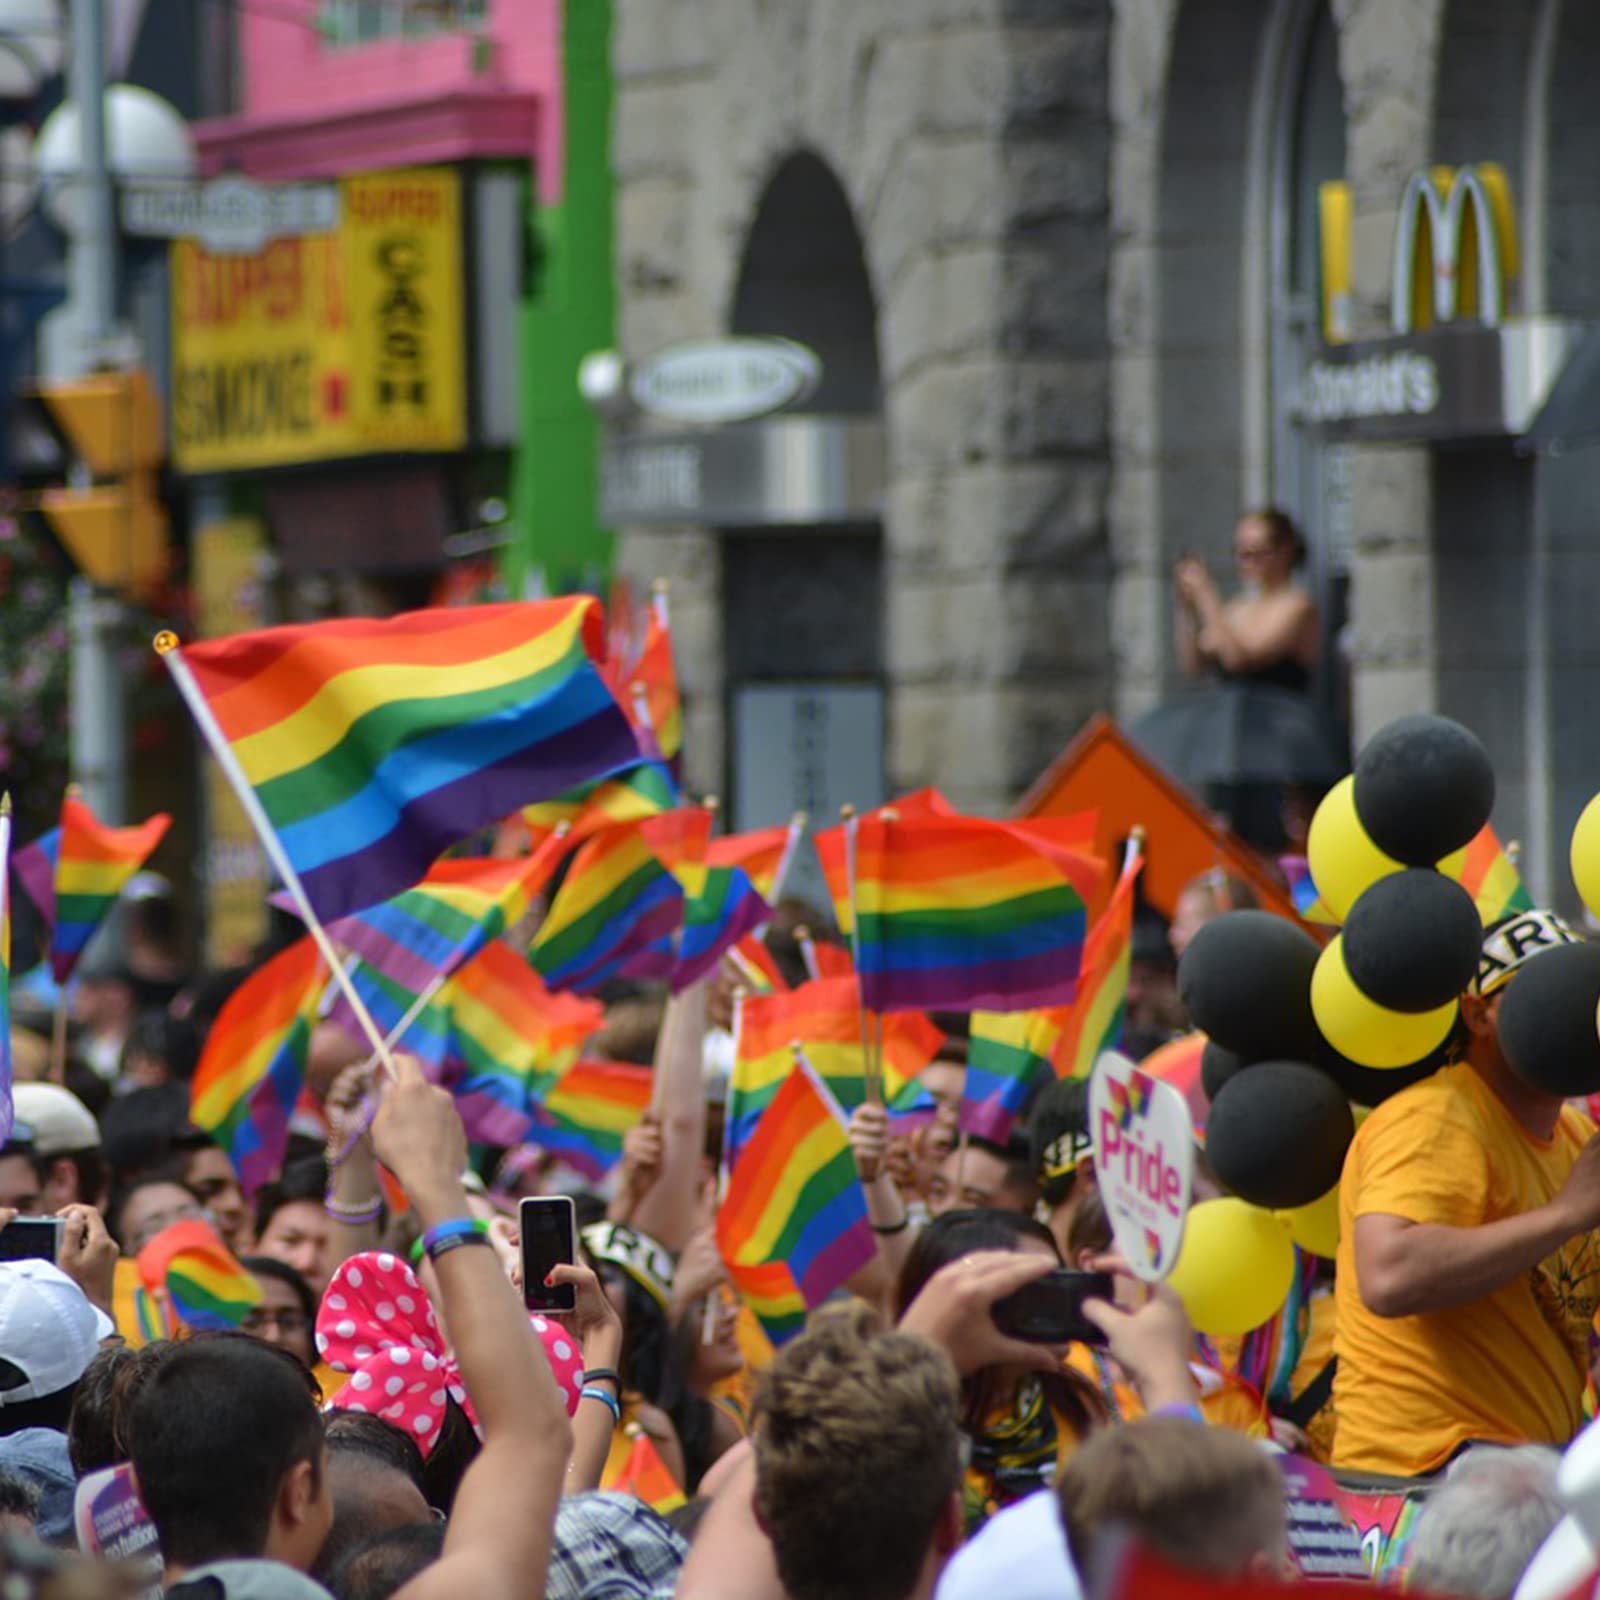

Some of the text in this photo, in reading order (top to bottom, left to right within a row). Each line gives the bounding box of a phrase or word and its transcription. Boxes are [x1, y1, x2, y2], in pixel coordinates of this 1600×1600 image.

[375, 238, 430, 412] CASH
[1300, 352, 1439, 422] onald's
[1100, 1106, 1181, 1219] Pride
